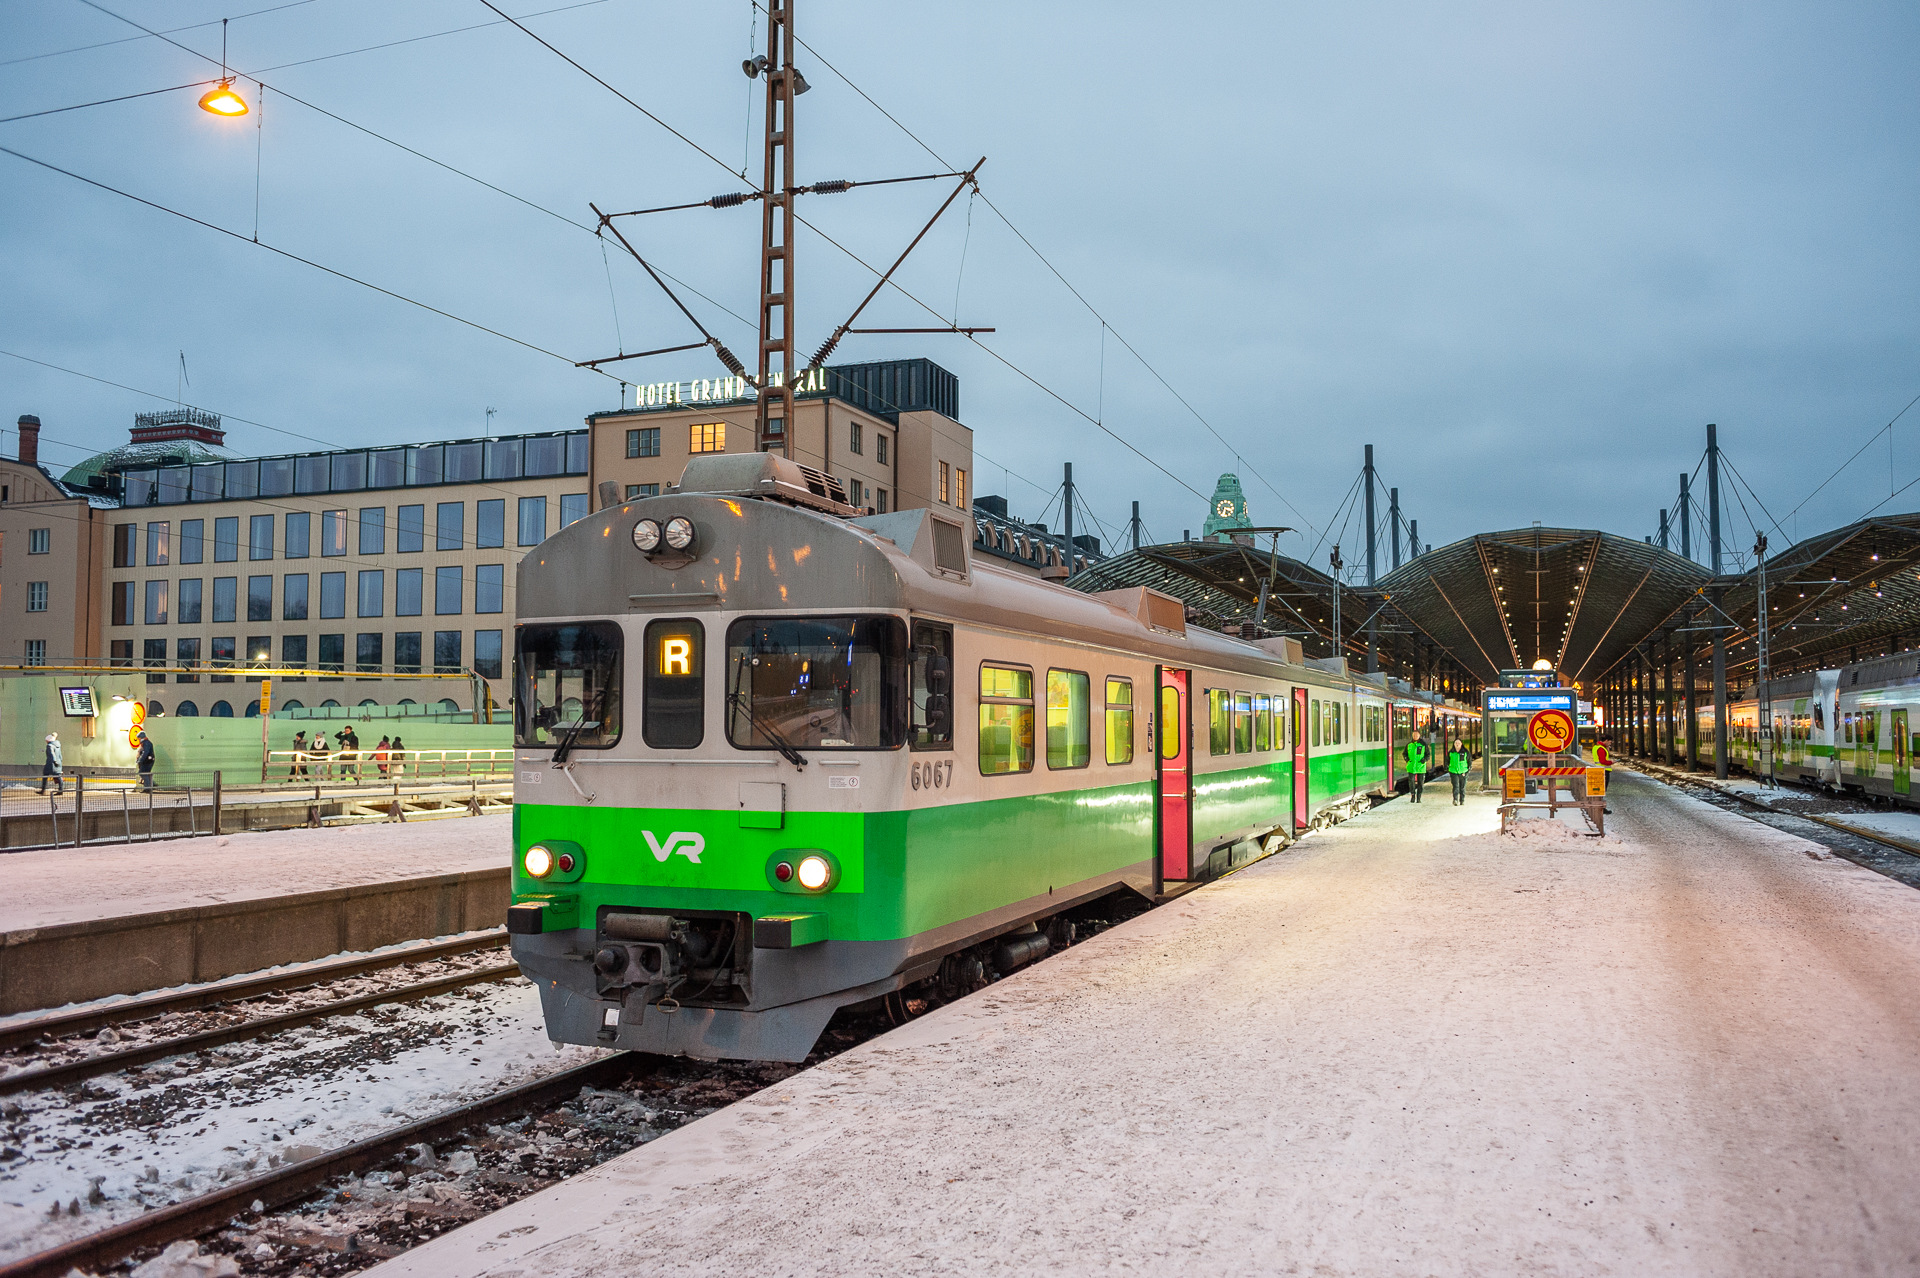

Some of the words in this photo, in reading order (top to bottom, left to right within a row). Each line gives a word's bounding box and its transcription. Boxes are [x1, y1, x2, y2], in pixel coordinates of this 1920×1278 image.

[636, 381, 682, 406] HOTEL
[691, 375, 745, 401] GRAND
[754, 368, 827, 396] NRAL
[664, 639, 689, 674] R
[911, 760, 953, 790] 6067
[641, 830, 705, 862] VR
